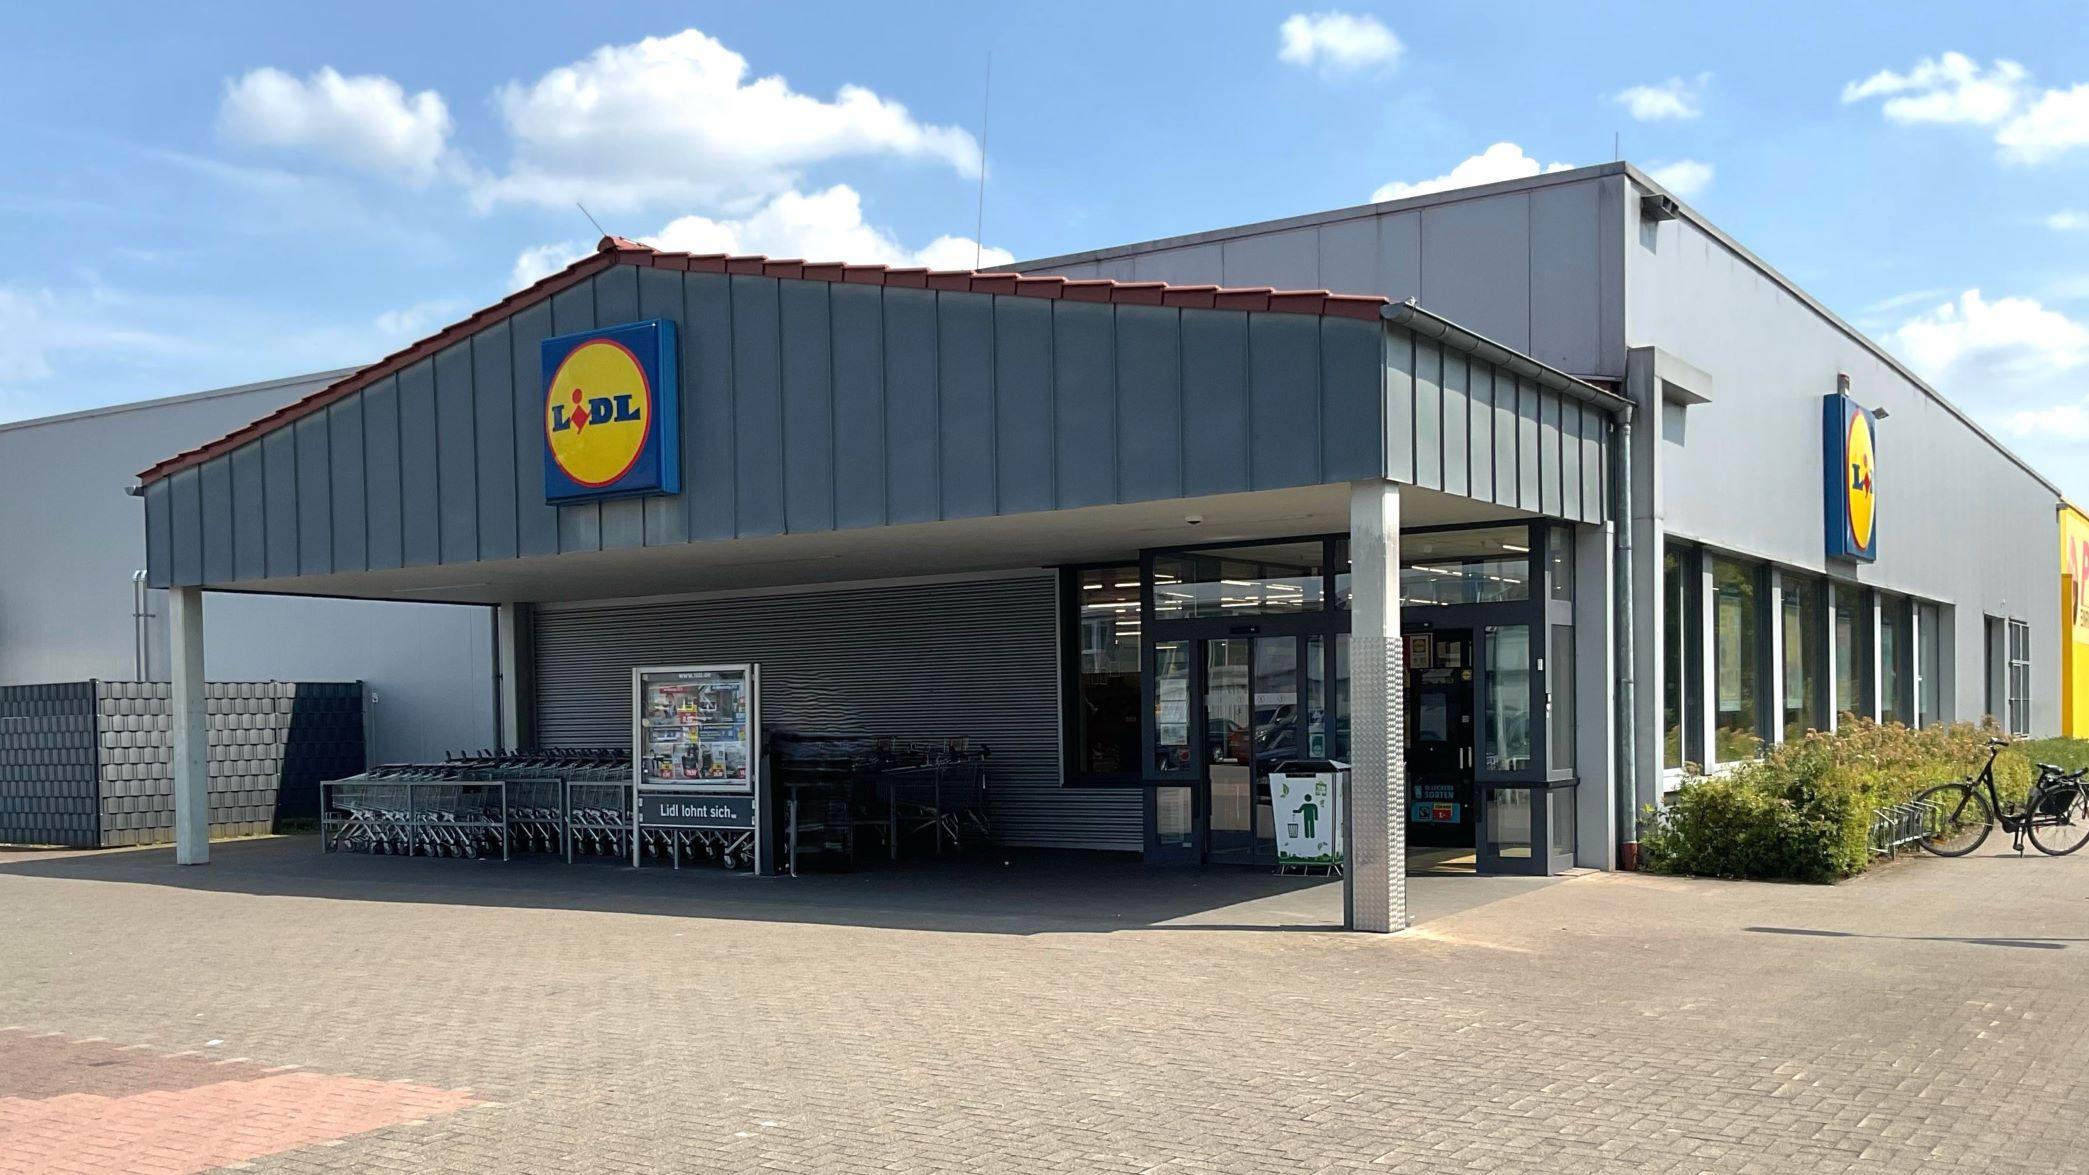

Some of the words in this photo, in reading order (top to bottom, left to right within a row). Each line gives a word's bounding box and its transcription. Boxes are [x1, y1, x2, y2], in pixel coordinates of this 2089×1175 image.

[551, 388, 641, 435] LIDL
[660, 803, 679, 817] Lidl
[681, 804, 708, 818] lohnt
